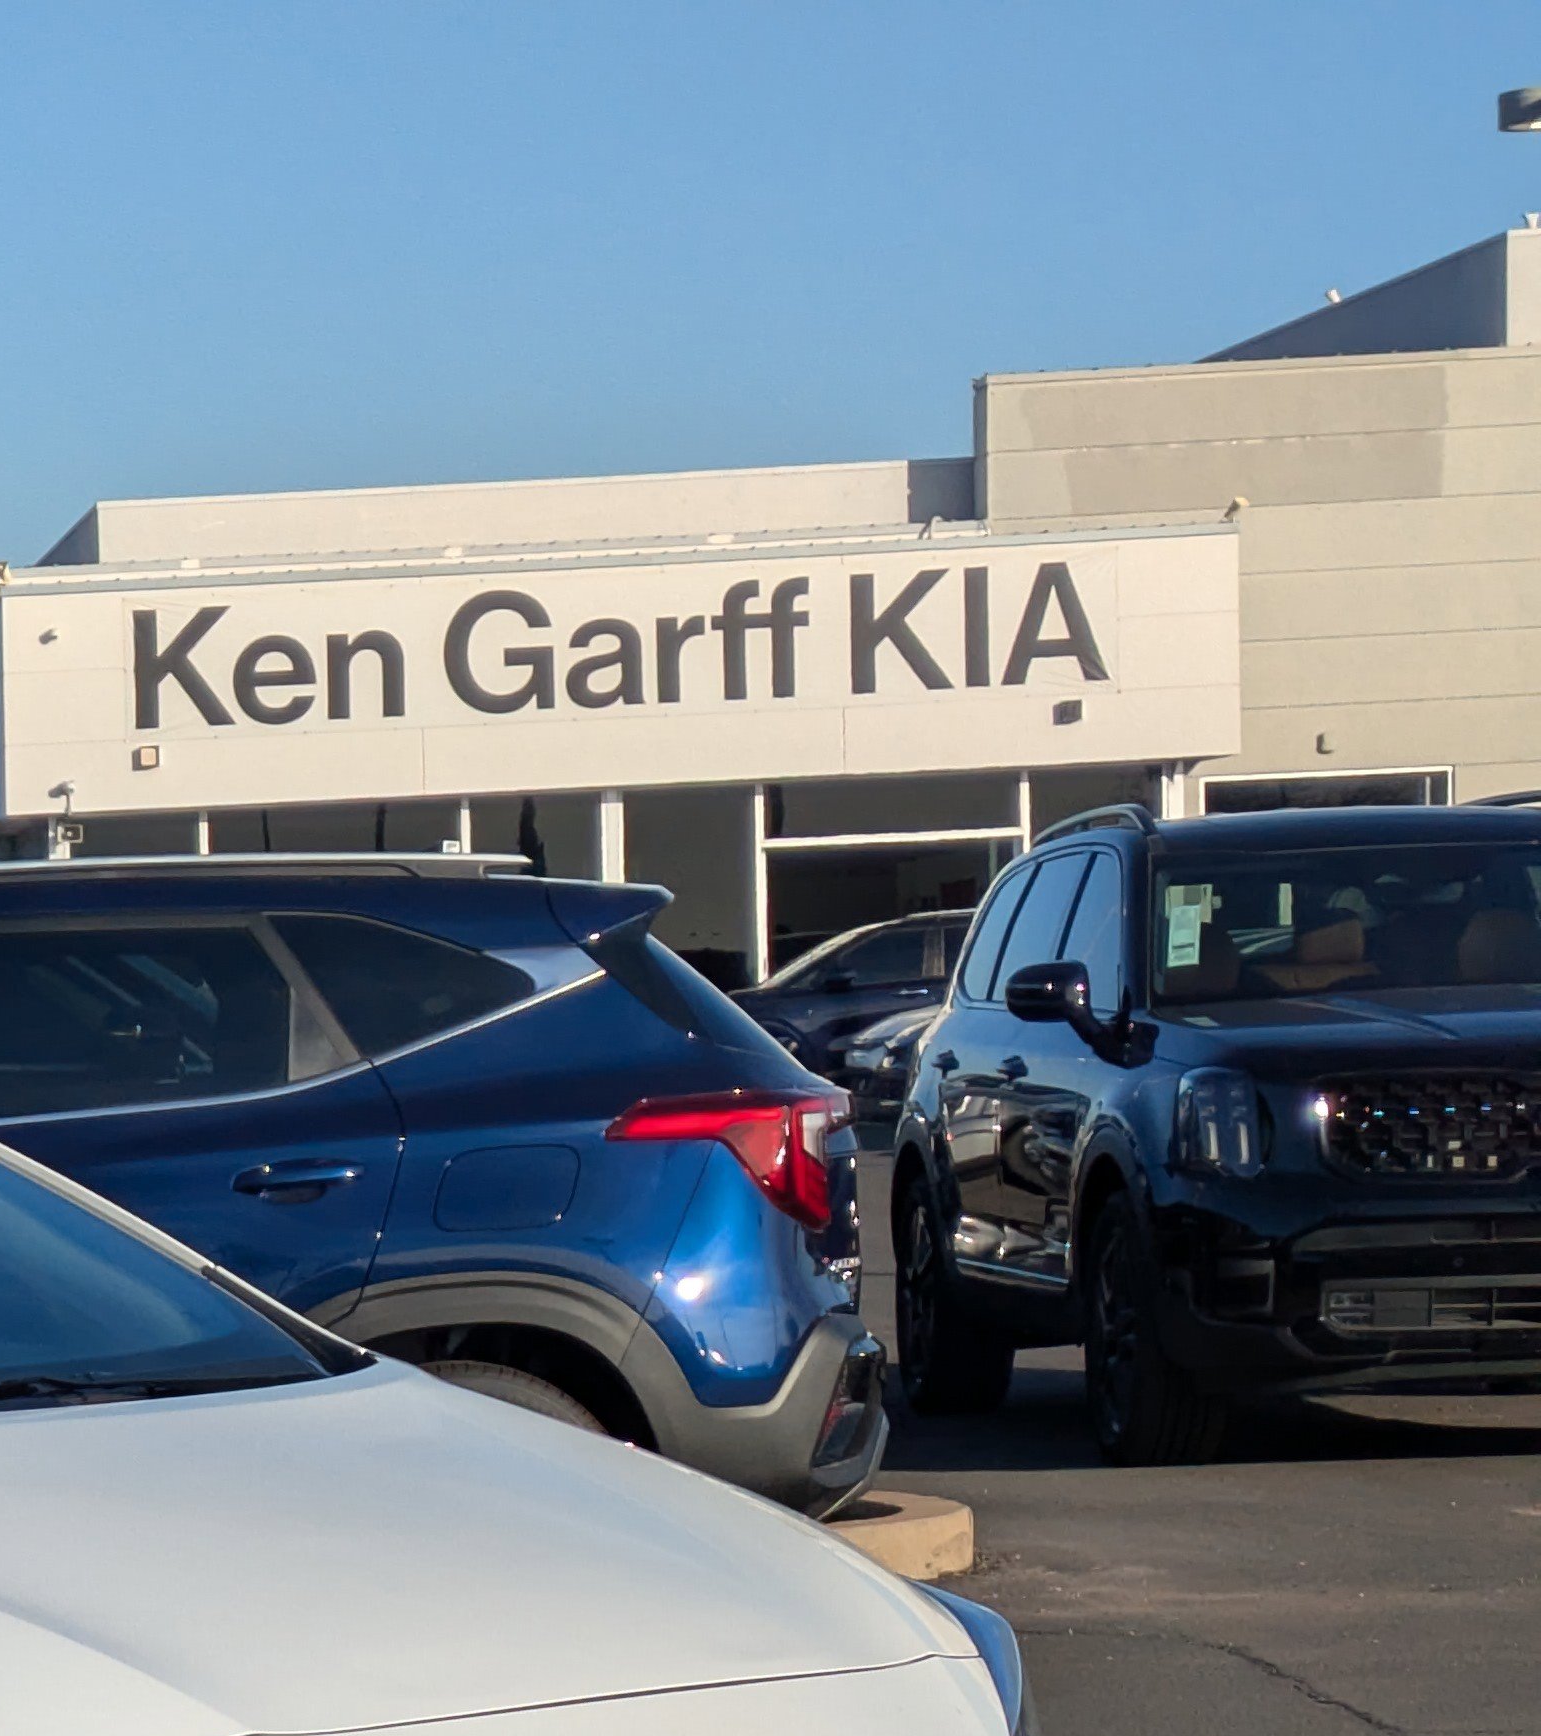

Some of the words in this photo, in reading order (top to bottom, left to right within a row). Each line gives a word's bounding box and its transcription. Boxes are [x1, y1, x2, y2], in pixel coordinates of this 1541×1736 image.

[133, 606, 405, 730] Ken
[443, 576, 810, 714] Garff
[849, 562, 1110, 695] KIA
